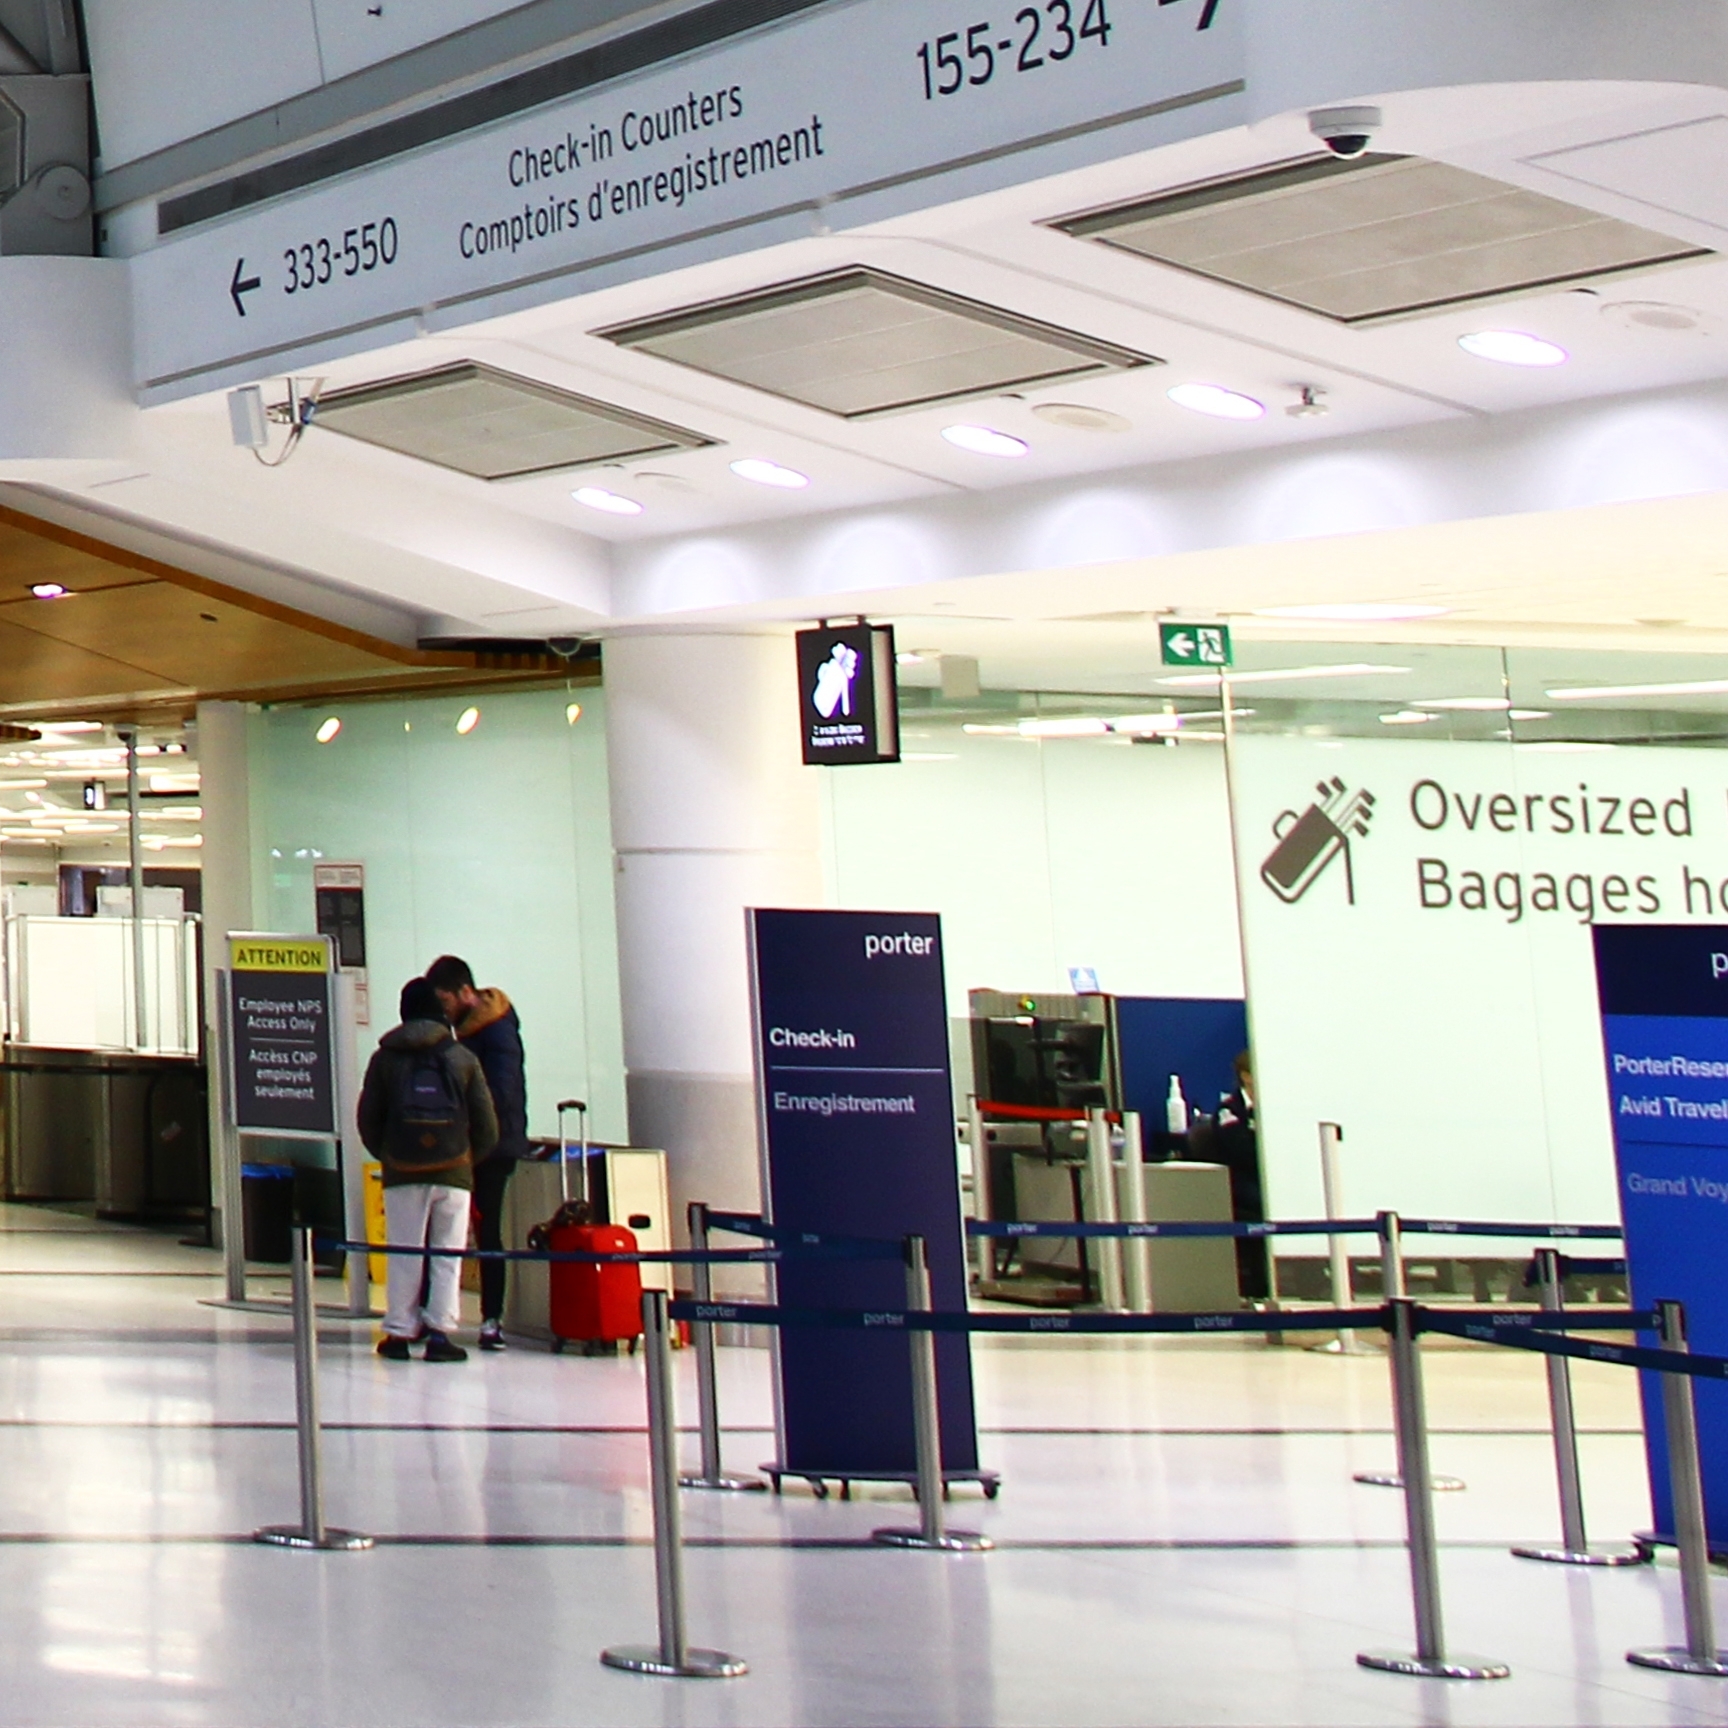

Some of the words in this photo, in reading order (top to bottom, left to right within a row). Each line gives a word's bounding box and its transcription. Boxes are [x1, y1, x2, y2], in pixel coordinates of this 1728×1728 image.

[508, 123, 614, 189] Check-in
[620, 80, 744, 156] Counters
[459, 190, 580, 262] Comptoirs
[588, 118, 825, 225] d'enregistrement
[283, 217, 399, 299] 333-550
[1410, 778, 1693, 837] Oversized
[1417, 857, 1661, 925] Bagages
[865, 931, 934, 959] porter
[237, 948, 322, 967] ATTENTION
[238, 997, 295, 1015] Employee
[297, 1000, 323, 1014] NPS
[247, 1015, 287, 1030] Access
[290, 1017, 317, 1034] Only
[769, 1027, 856, 1049] Check-in
[291, 1051, 319, 1065] CNP
[254, 1085, 315, 1100] seulement
[773, 1091, 916, 1116] Enregistrement
[1620, 1095, 1662, 1117] Avid
[1627, 1172, 1688, 1196] Grand
[695, 1304, 739, 1322] porter
[863, 1309, 906, 1329] porter
[1029, 1313, 1072, 1332] porter
[1193, 1310, 1235, 1331] porter
[1492, 1310, 1534, 1328] porter
